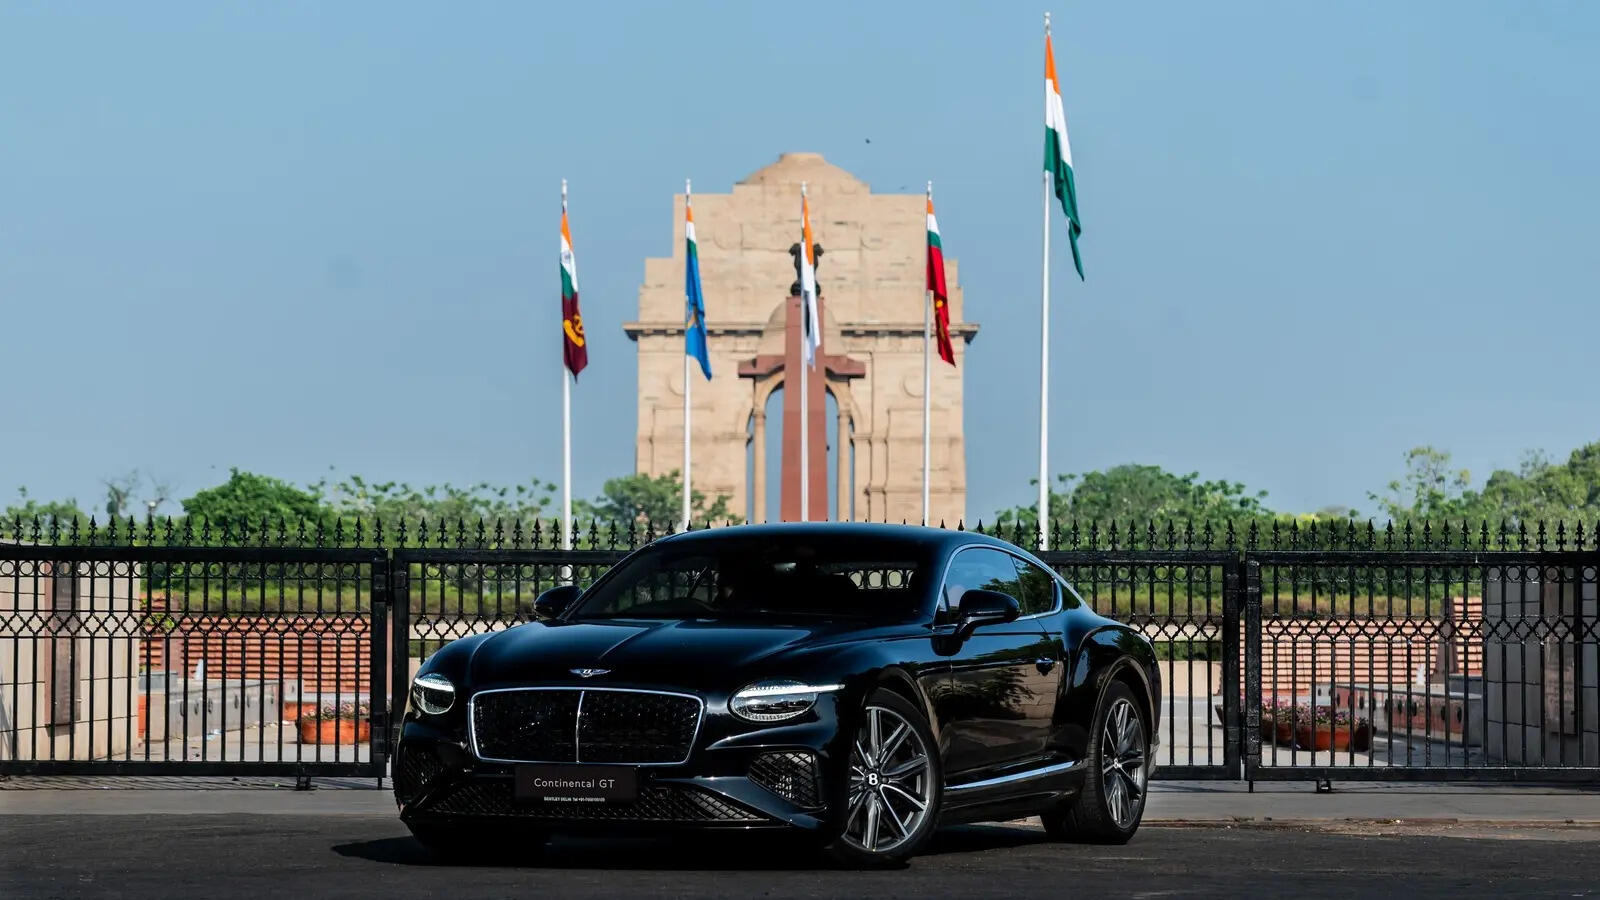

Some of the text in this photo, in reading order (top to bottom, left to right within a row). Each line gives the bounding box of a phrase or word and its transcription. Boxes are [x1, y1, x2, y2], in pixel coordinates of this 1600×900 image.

[534, 777, 616, 789] Continental GT
[868, 773, 878, 785] B
